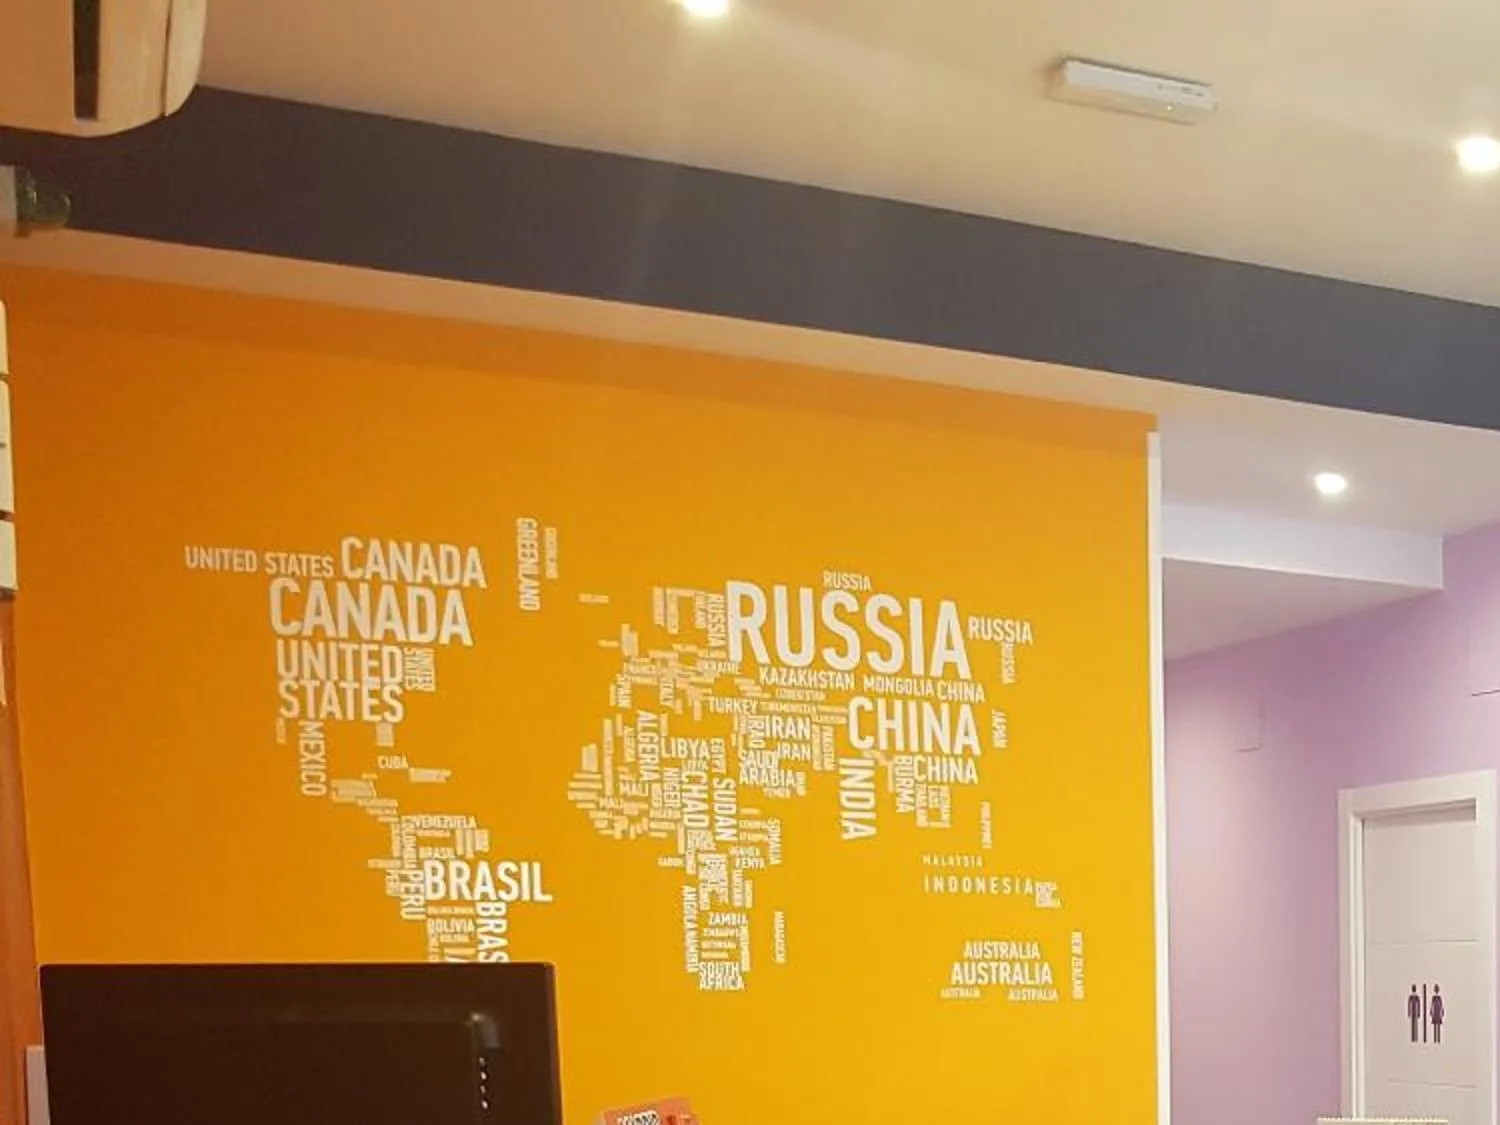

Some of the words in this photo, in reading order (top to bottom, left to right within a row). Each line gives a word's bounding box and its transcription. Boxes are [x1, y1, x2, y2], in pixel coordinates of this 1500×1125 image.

[184, 545, 258, 573] UNITED
[264, 552, 335, 578] STATES
[340, 536, 488, 589] CANADA
[516, 517, 541, 612] GREENLAND
[822, 570, 873, 591] RUSSIA
[268, 577, 474, 647] CANADA
[707, 592, 727, 649] RUSSIA
[725, 579, 973, 680] RUSSIA
[967, 615, 1034, 645] RUSSIA
[275, 639, 404, 689] UNITED
[404, 646, 420, 691] STATES
[419, 646, 437, 692] UNITED
[758, 665, 856, 691] KAZAKHSTAN
[278, 675, 405, 724] STATES
[862, 674, 936, 698] MONGOLIA
[935, 680, 986, 705] CHINA
[708, 696, 760, 715] TURKEY
[747, 713, 767, 750] IRAQ
[764, 716, 812, 740] IRAN
[848, 694, 983, 758] CHINA
[991, 708, 1009, 750] JAPAN
[299, 720, 328, 798] MEXICO
[377, 755, 410, 770] CUBA
[636, 709, 661, 782] ALGERIA
[660, 737, 712, 761] LIBYA
[776, 742, 812, 762] IRAN
[662, 766, 681, 809] NIGER
[896, 755, 915, 814] BURMA
[912, 755, 979, 785] CHINA
[619, 782, 649, 798] MALI
[681, 771, 710, 828] CHAD
[838, 756, 878, 841] INDIA
[712, 777, 738, 842] SUDAN
[419, 846, 456, 860] BRASIL
[922, 854, 984, 868] MALAYSIA
[400, 869, 426, 921] PERU
[423, 859, 554, 903] BRASIL
[923, 874, 1035, 896] INDONESIA
[699, 961, 740, 977] SOUTH
[963, 940, 1041, 961] AUSTRALIA
[699, 975, 745, 991] AFRICA
[951, 961, 1053, 986] AUSTRALIA
